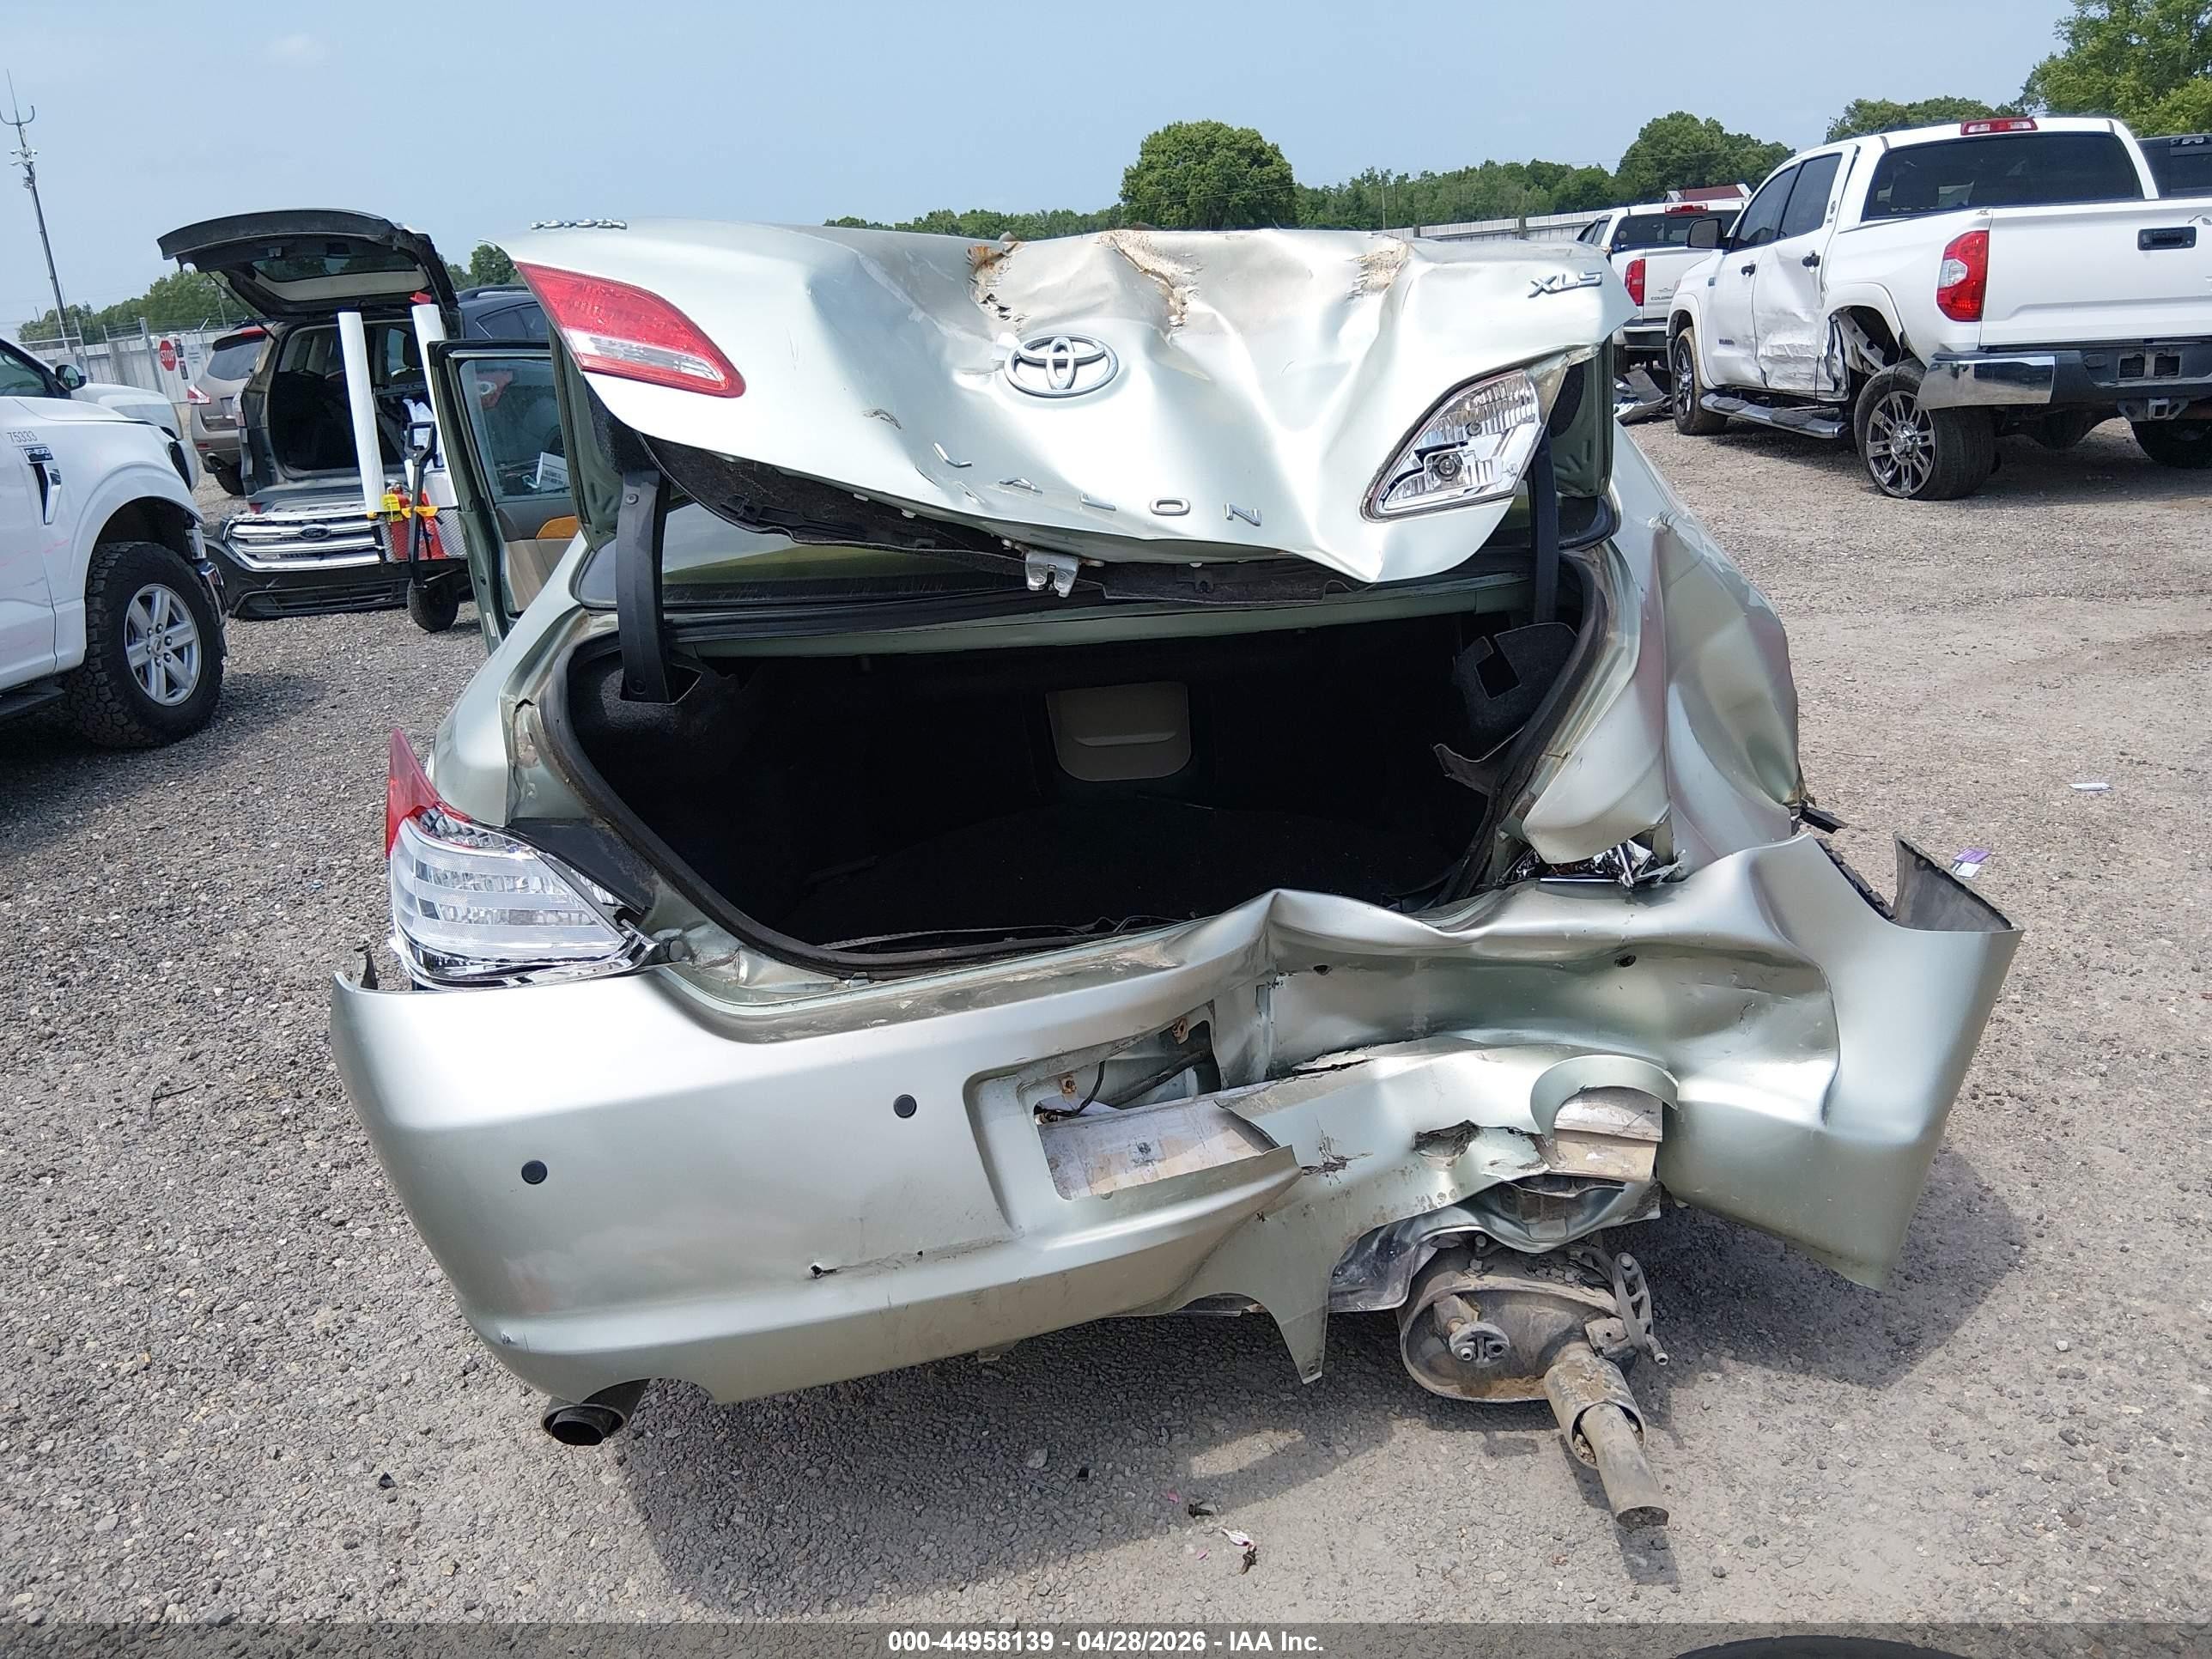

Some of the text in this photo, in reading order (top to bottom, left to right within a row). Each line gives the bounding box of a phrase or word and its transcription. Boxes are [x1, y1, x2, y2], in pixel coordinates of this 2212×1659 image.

[1528, 271, 1602, 299] XLS
[160, 349, 175, 362] STOP
[7, 430, 38, 443] 75333
